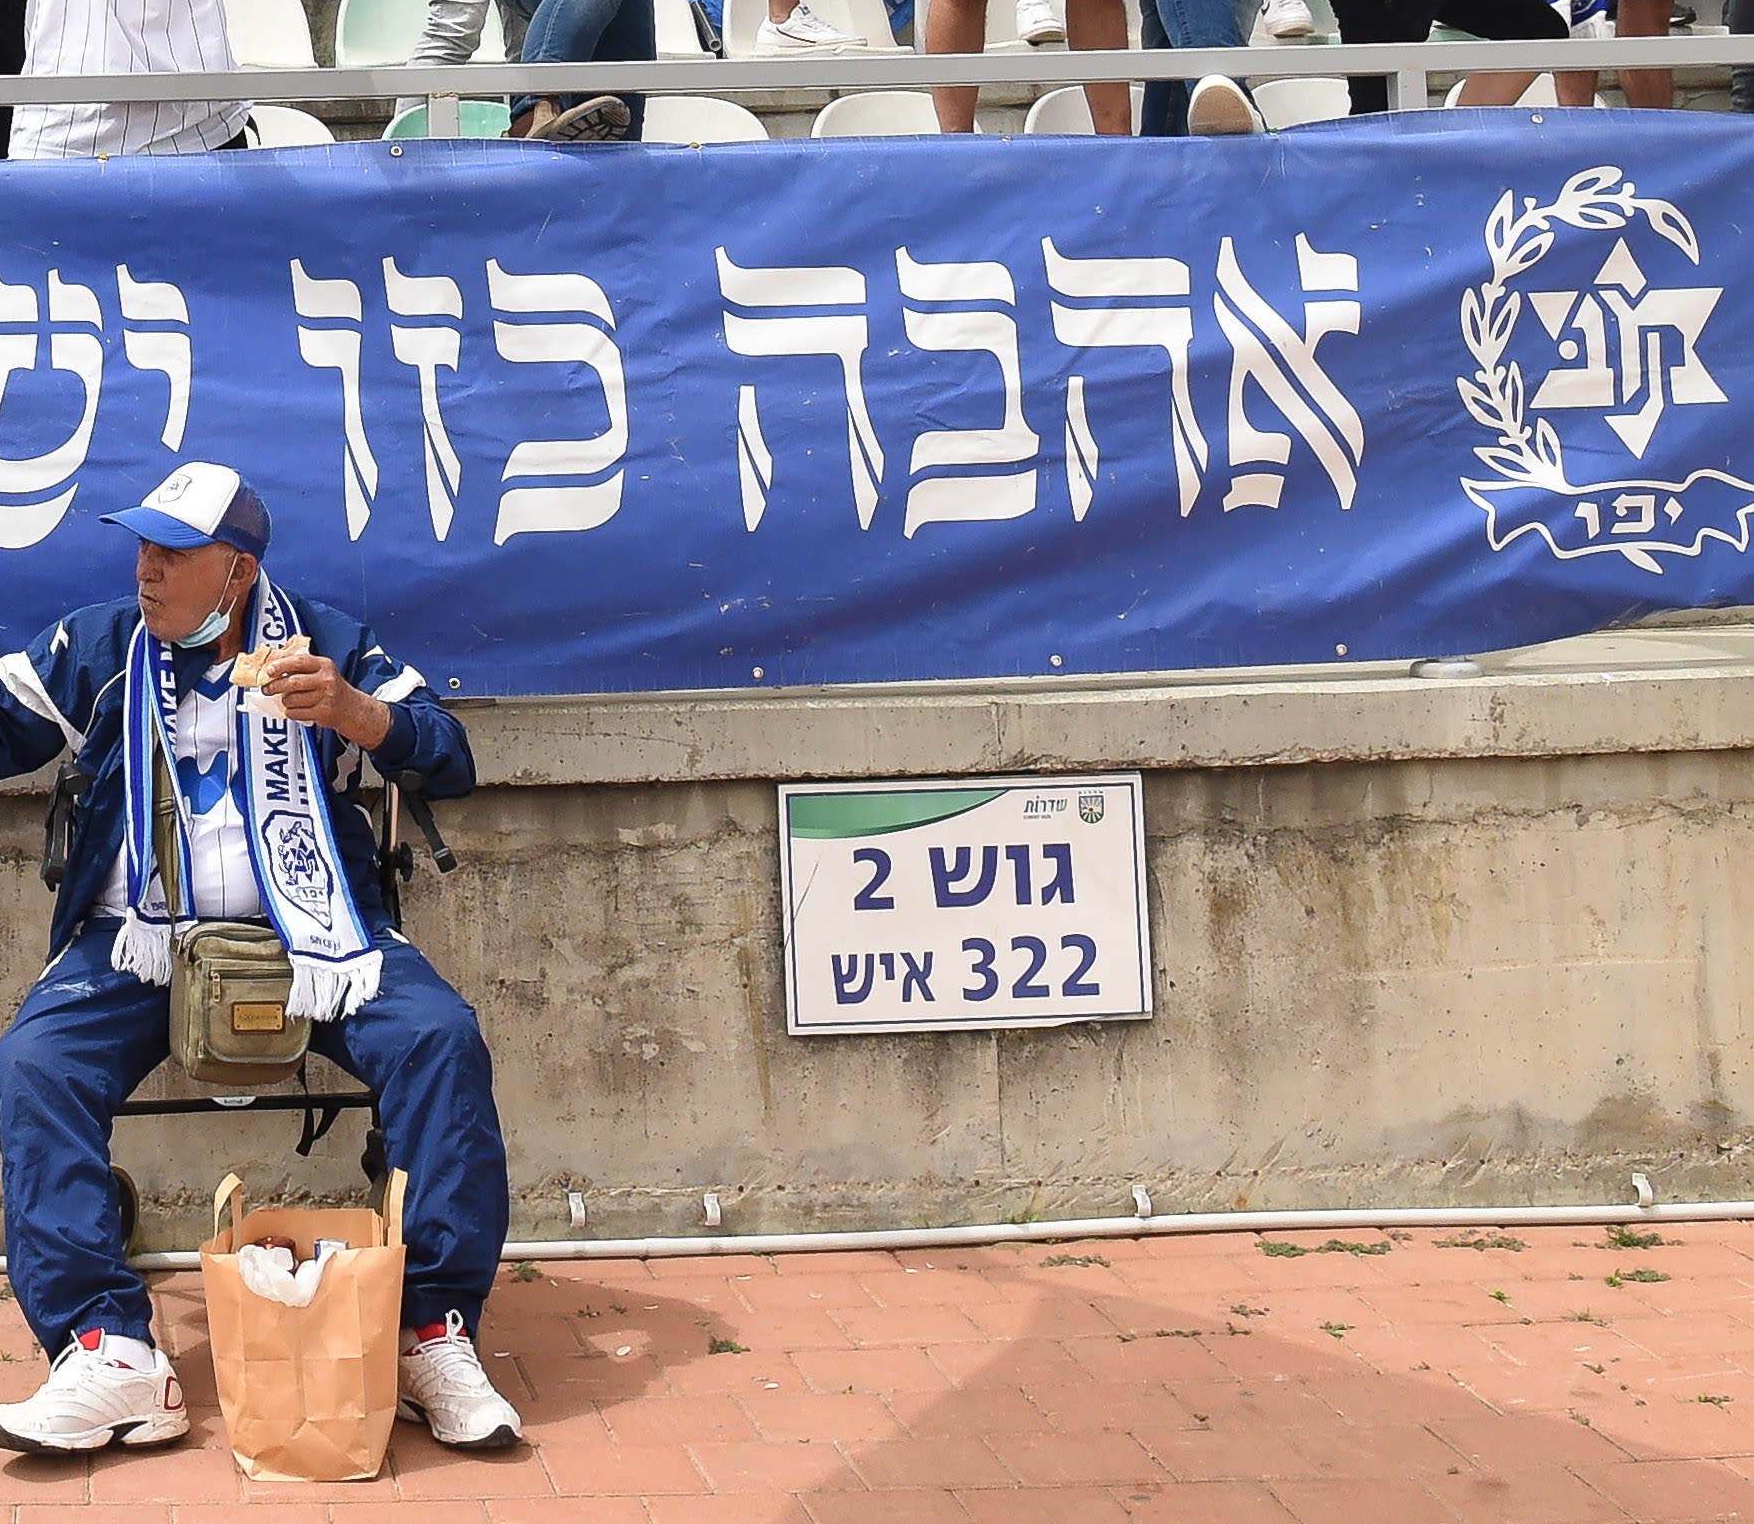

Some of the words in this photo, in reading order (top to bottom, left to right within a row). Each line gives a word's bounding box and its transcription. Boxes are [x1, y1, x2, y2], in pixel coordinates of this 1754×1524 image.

[290, 255, 629, 546] כזו
[714, 233, 1365, 539] אהבה
[1574, 493, 1685, 539] יפו
[262, 716, 290, 802] MAKE
[852, 847, 896, 911] 2
[928, 842, 1076, 909] גוש
[830, 951, 937, 1005] איש
[961, 933, 1101, 1002] 322
